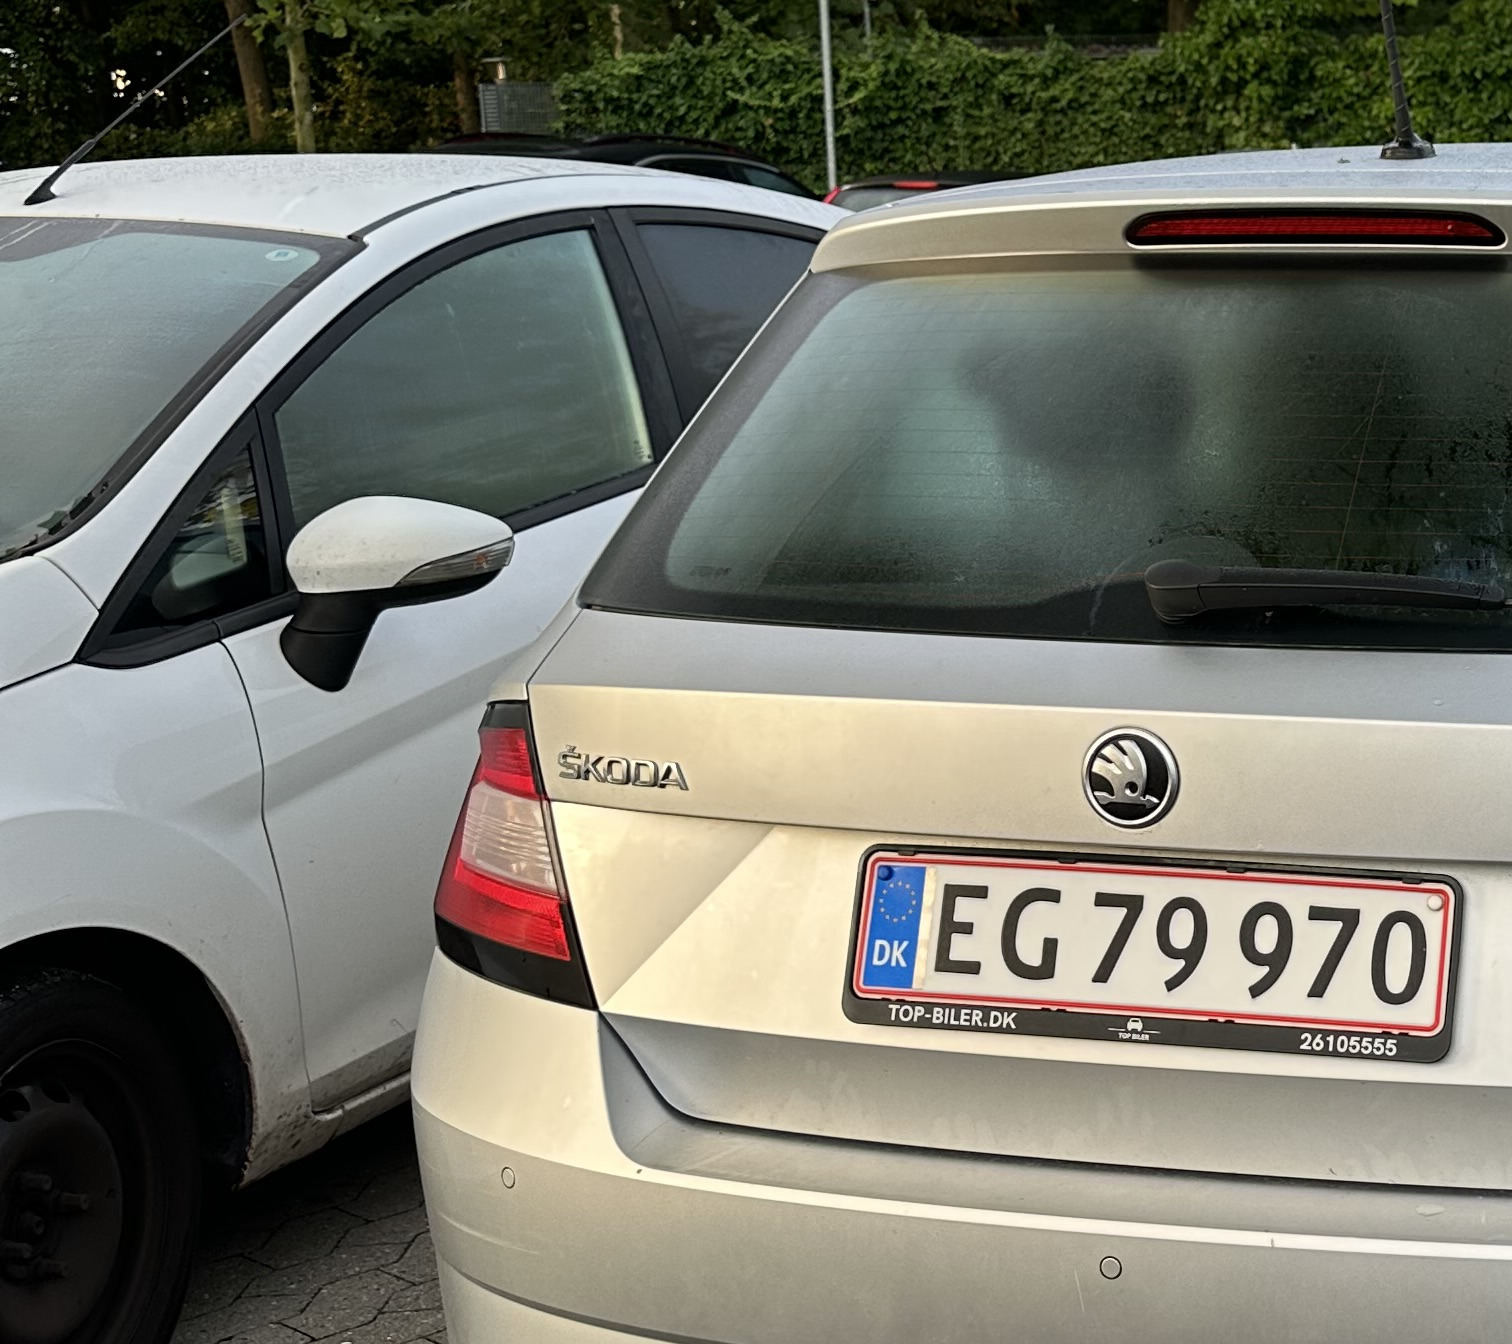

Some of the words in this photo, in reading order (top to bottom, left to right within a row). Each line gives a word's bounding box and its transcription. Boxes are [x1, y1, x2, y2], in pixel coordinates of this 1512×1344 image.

[558, 744, 690, 791] ŠKODA
[872, 939, 909, 967] DK
[934, 883, 1062, 981] EG
[1091, 891, 1209, 993] 79
[1239, 901, 1428, 1006] 970
[888, 1004, 1017, 1029] TOP-BILER.DK
[1299, 1032, 1398, 1056] 26105555
